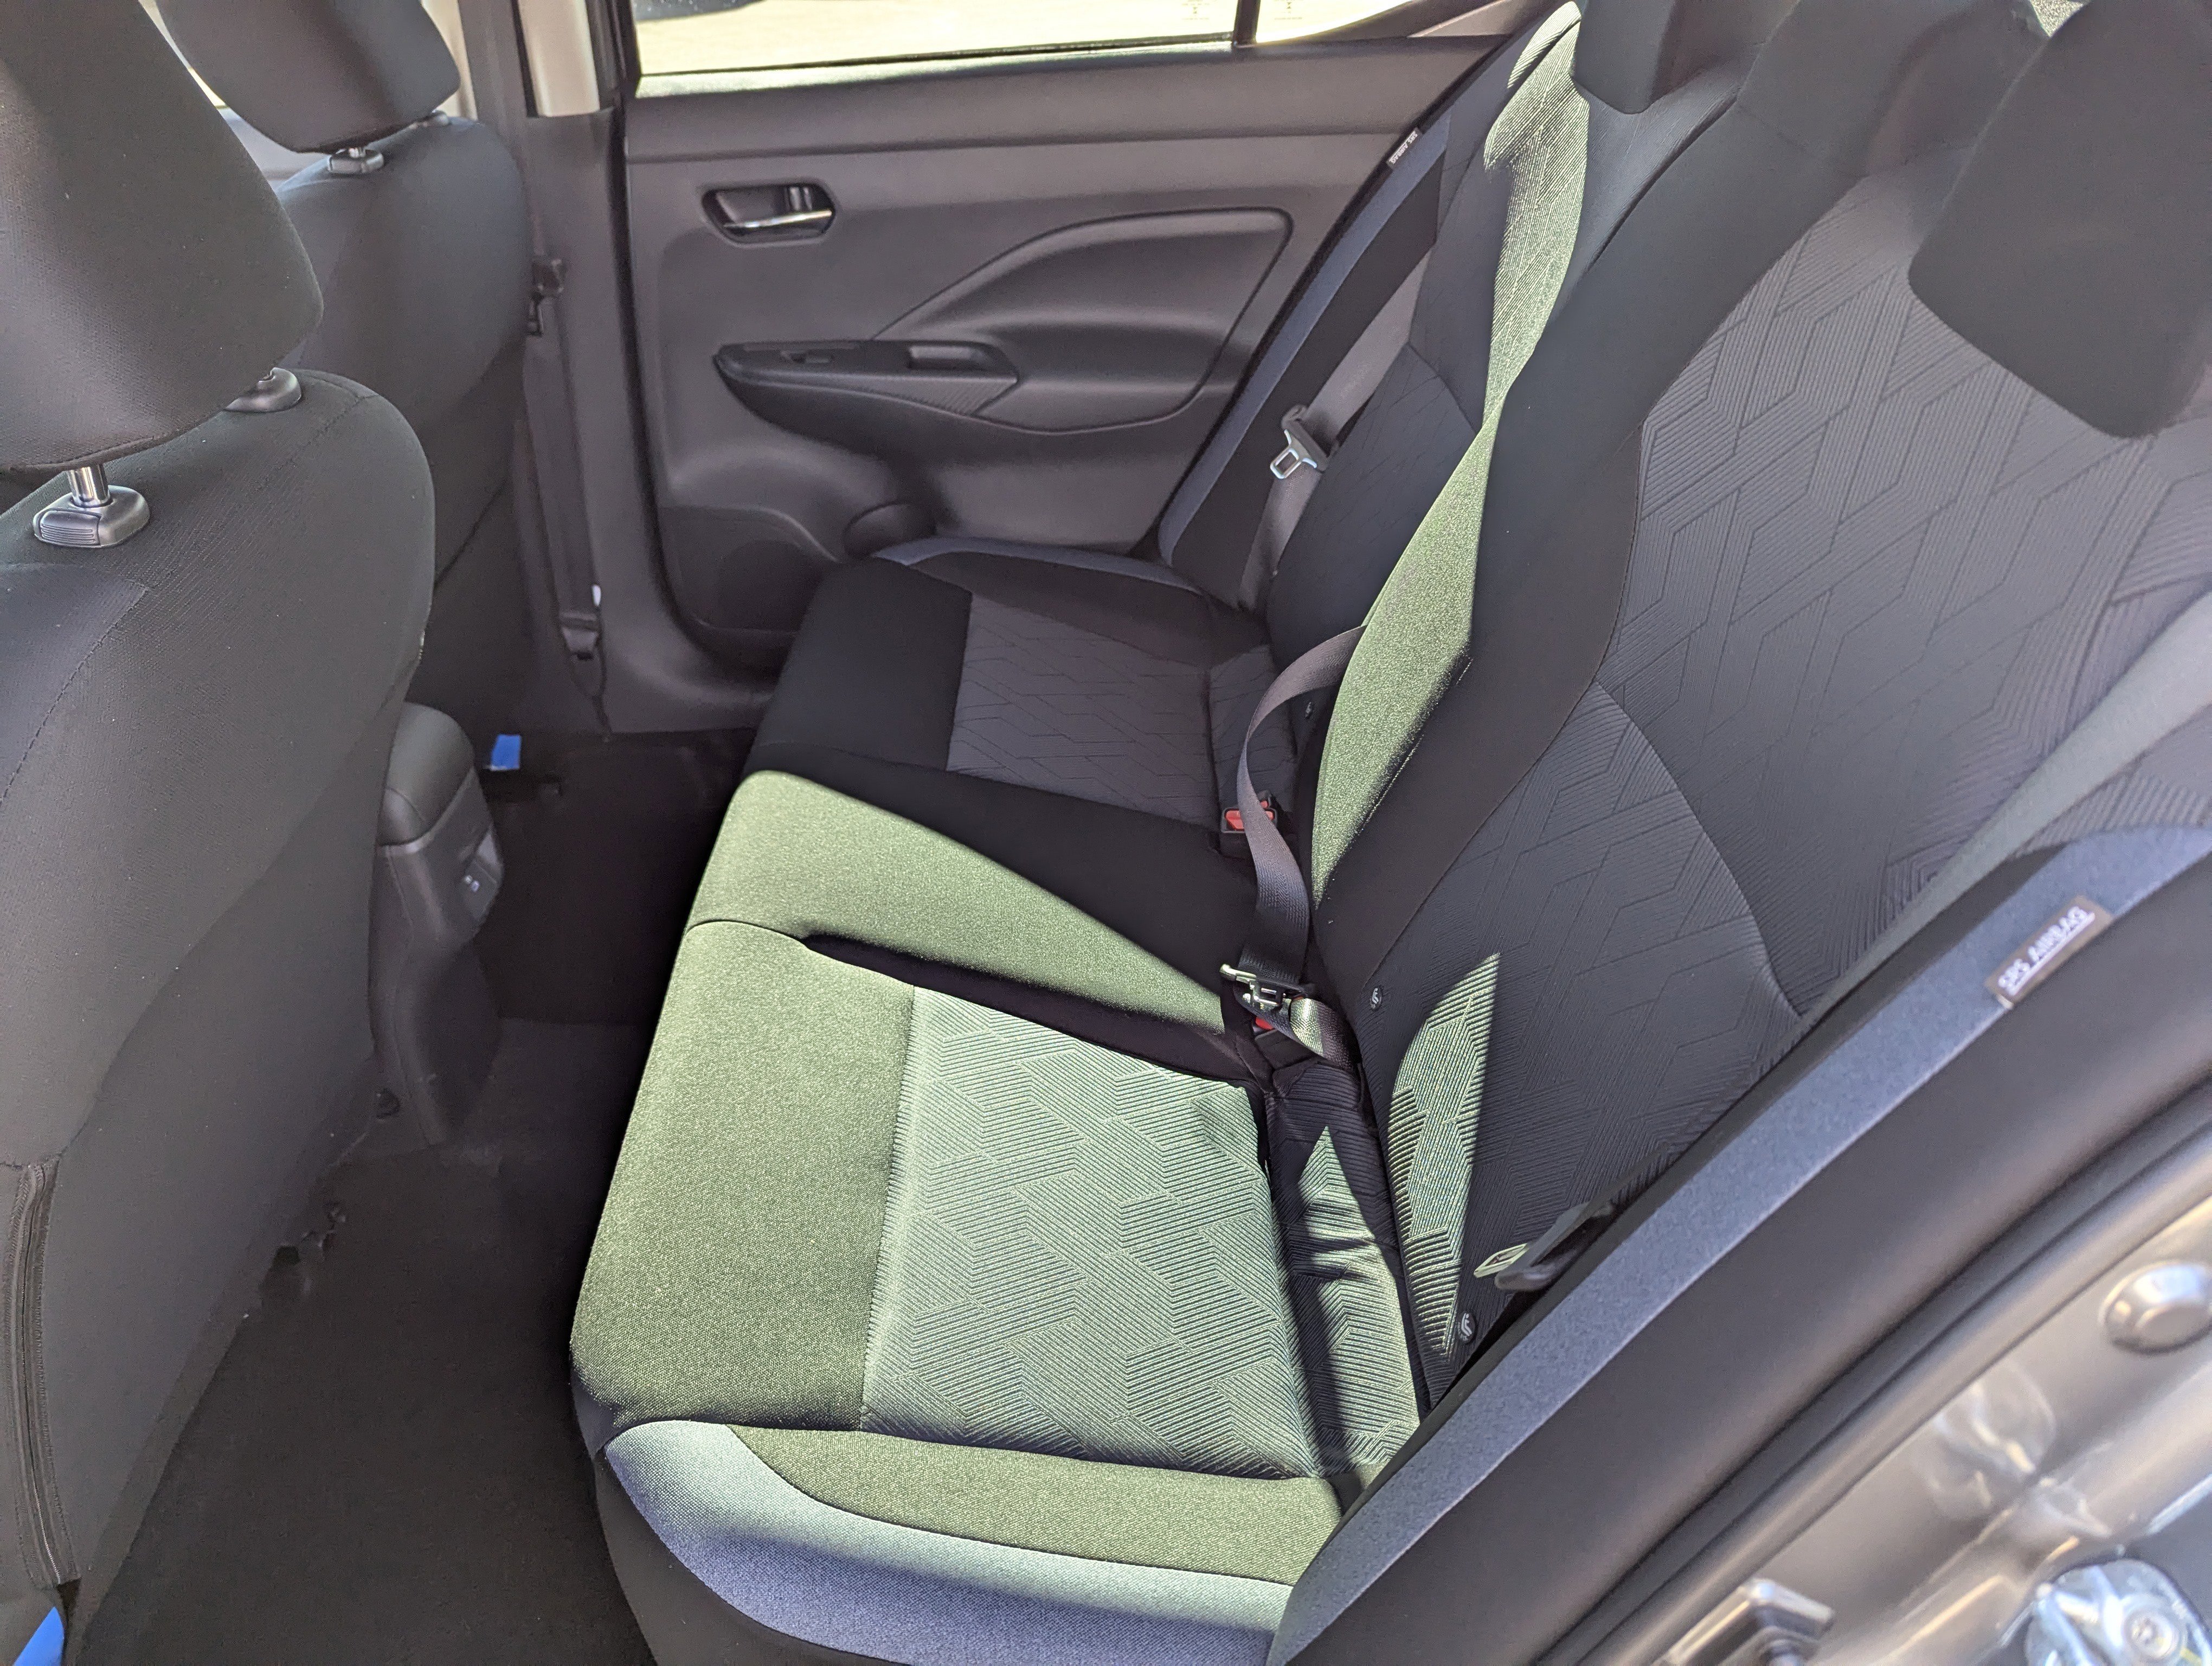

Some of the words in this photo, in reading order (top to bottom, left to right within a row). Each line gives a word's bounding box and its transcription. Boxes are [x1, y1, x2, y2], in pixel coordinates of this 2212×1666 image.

[1407, 132, 1418, 144] SRS
[1390, 143, 1409, 164] AIRBAG
[1997, 958, 2030, 990] SRS
[2027, 906, 2089, 962] AIRBAG
